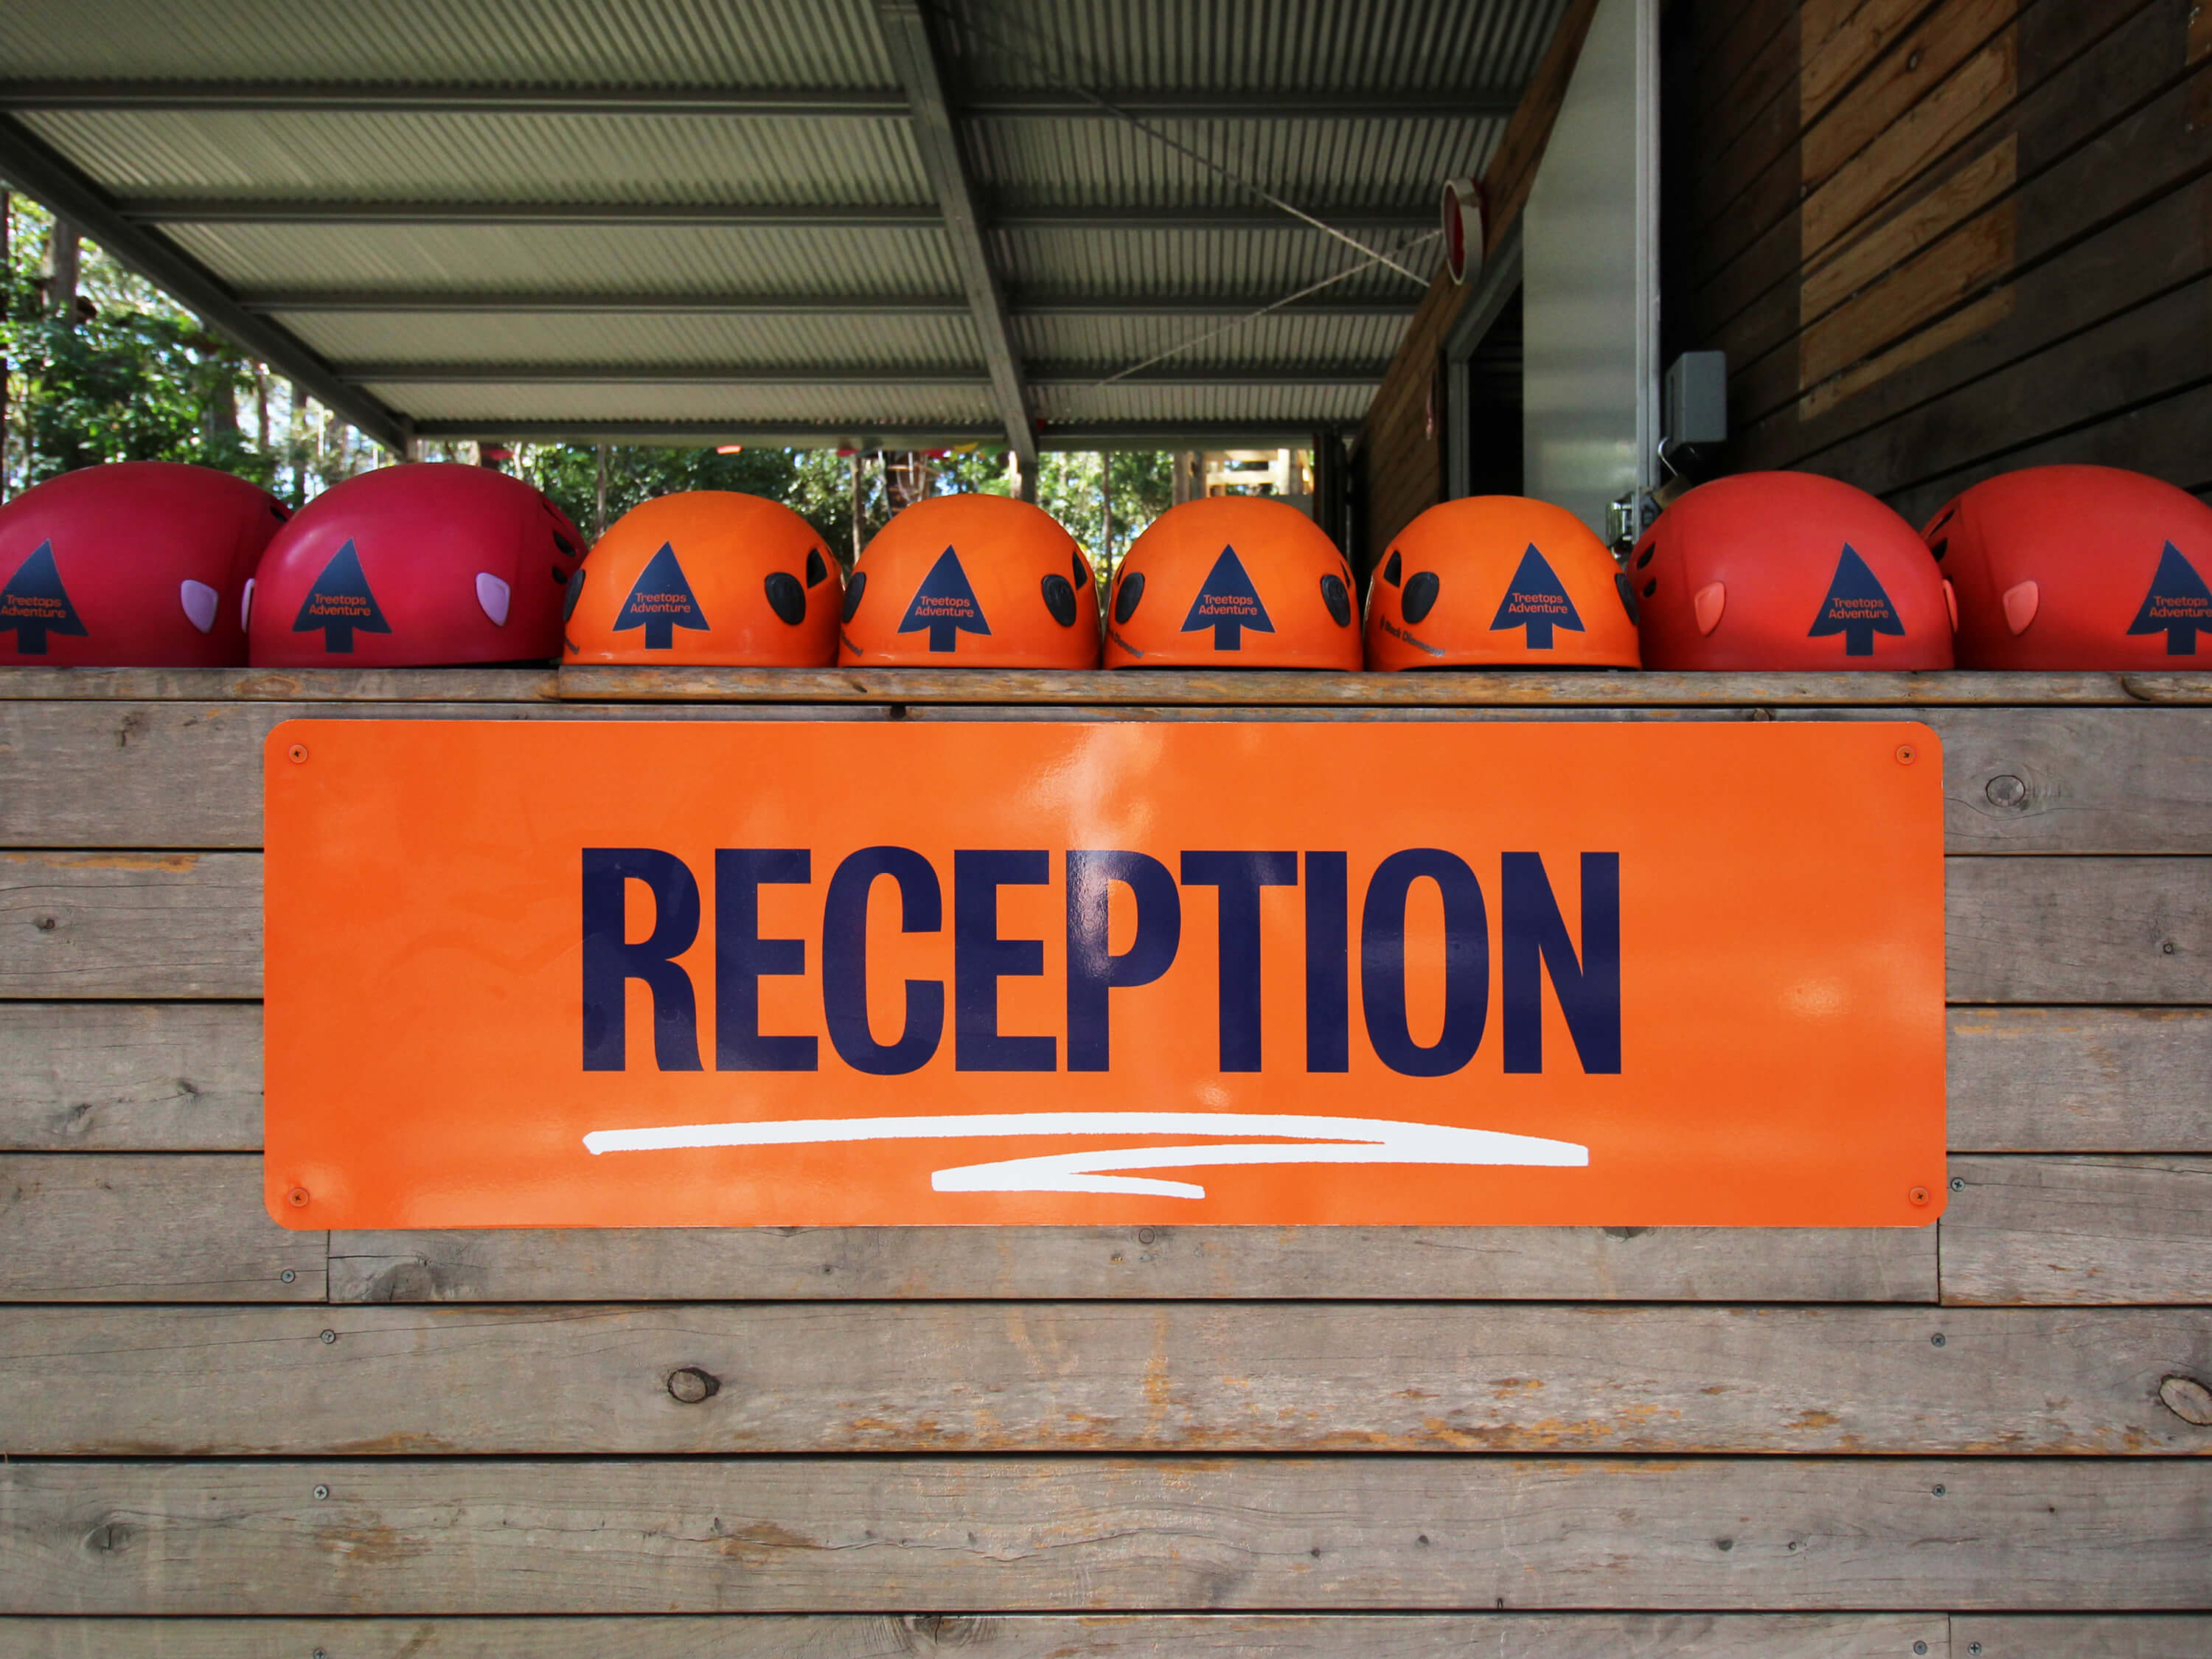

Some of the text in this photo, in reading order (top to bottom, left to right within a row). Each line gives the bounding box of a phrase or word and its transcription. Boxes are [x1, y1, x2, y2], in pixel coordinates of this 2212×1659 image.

[6, 594, 61, 608] Treetops
[314, 594, 366, 606] Treetops
[635, 593, 687, 603] Treetops
[920, 596, 971, 608] Treetops
[1203, 594, 1253, 605] Treetops
[1512, 593, 1564, 605] Treetops
[1832, 598, 1884, 609] Treetops
[2154, 596, 2208, 608] Treetops
[1, 605, 66, 619] Adventure
[309, 605, 372, 616] Adventure
[630, 603, 691, 613] Adventure
[915, 606, 974, 618] Adventure
[1198, 605, 1258, 616] Adventure
[1509, 603, 1568, 614] Adventure
[1829, 608, 1889, 619] Adventure
[2149, 607, 2212, 618] Adventure
[582, 846, 1622, 1077] RECEPTION
